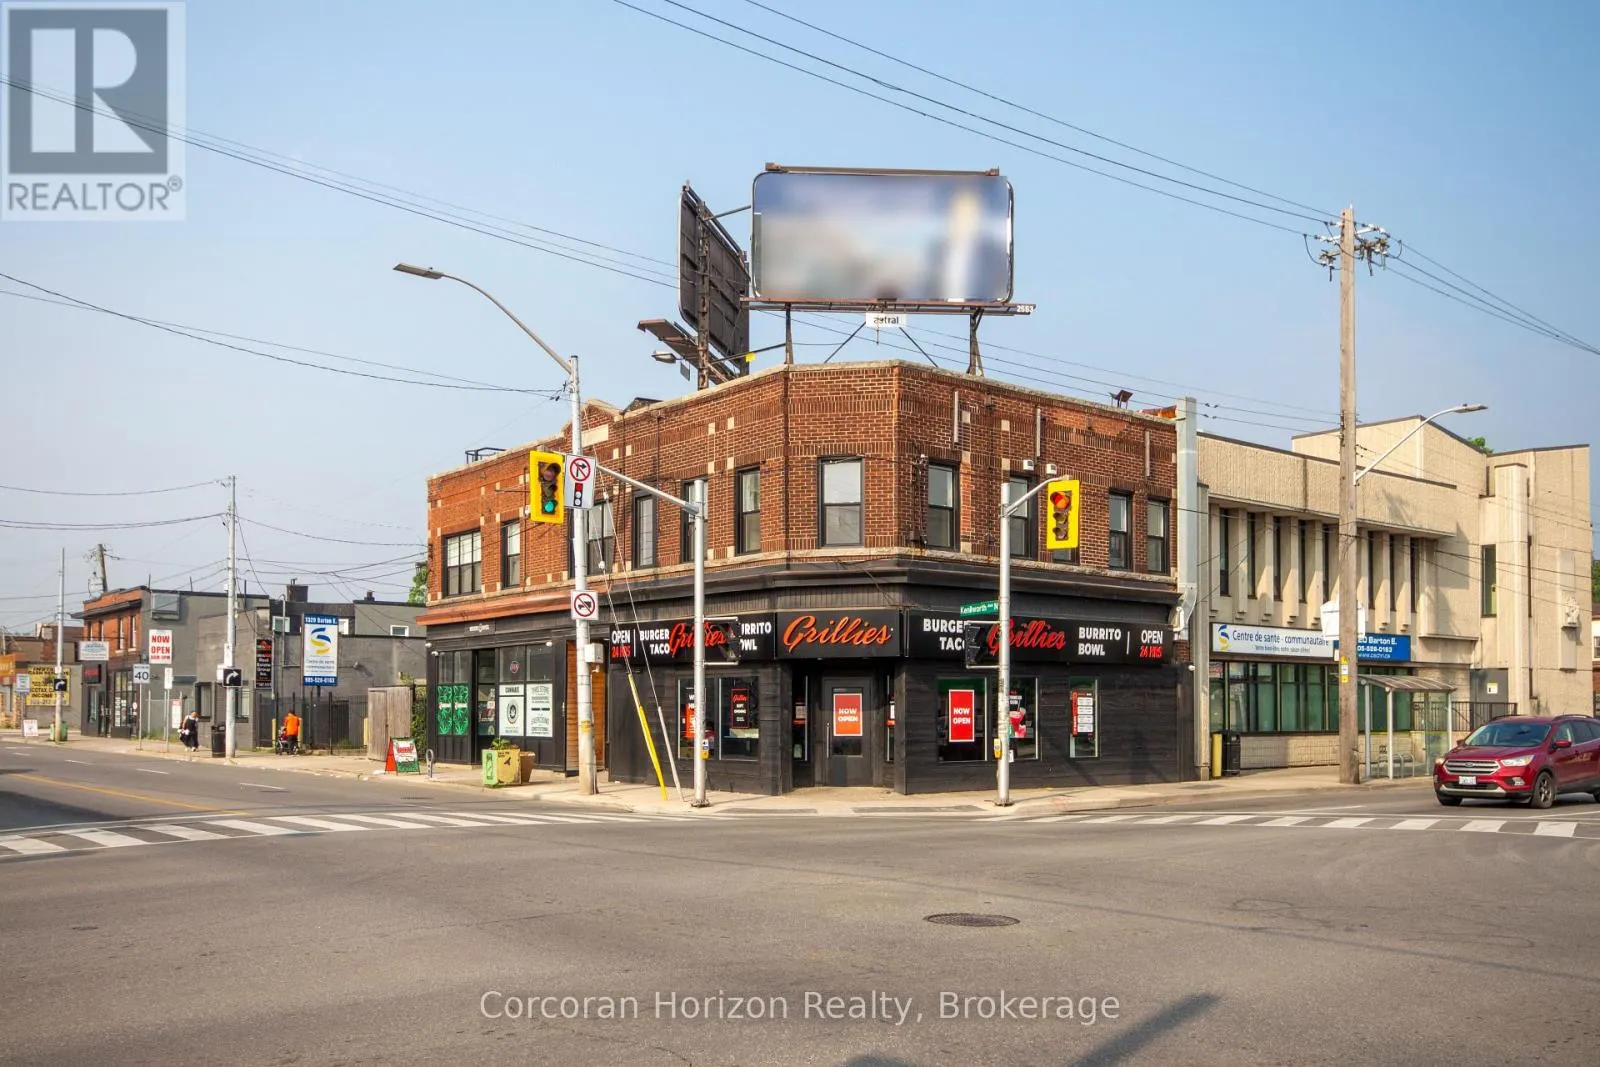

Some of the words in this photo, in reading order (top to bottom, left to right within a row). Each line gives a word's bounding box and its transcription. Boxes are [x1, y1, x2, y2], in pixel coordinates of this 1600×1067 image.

[960, 603, 988, 614] Kenilworth
[993, 602, 999, 611] N
[151, 635, 170, 643] NOW
[611, 630, 631, 644] OPEN
[639, 628, 670, 641] BURGER
[783, 615, 891, 653] Grillies
[1078, 626, 1122, 641] BURRITO
[1140, 629, 1164, 644] OPEN
[1232, 630, 1254, 642] Centre
[1254, 631, 1263, 642] de
[1368, 636, 1390, 645] Barton
[151, 646, 170, 654] OPEN
[649, 643, 670, 655] TACO
[1078, 642, 1106, 656] BOWL
[1139, 645, 1148, 658] 24
[1148, 646, 1163, 658] HRS
[134, 671, 149, 681] 40
[838, 707, 857, 715] NOW
[953, 707, 970, 715] NOW
